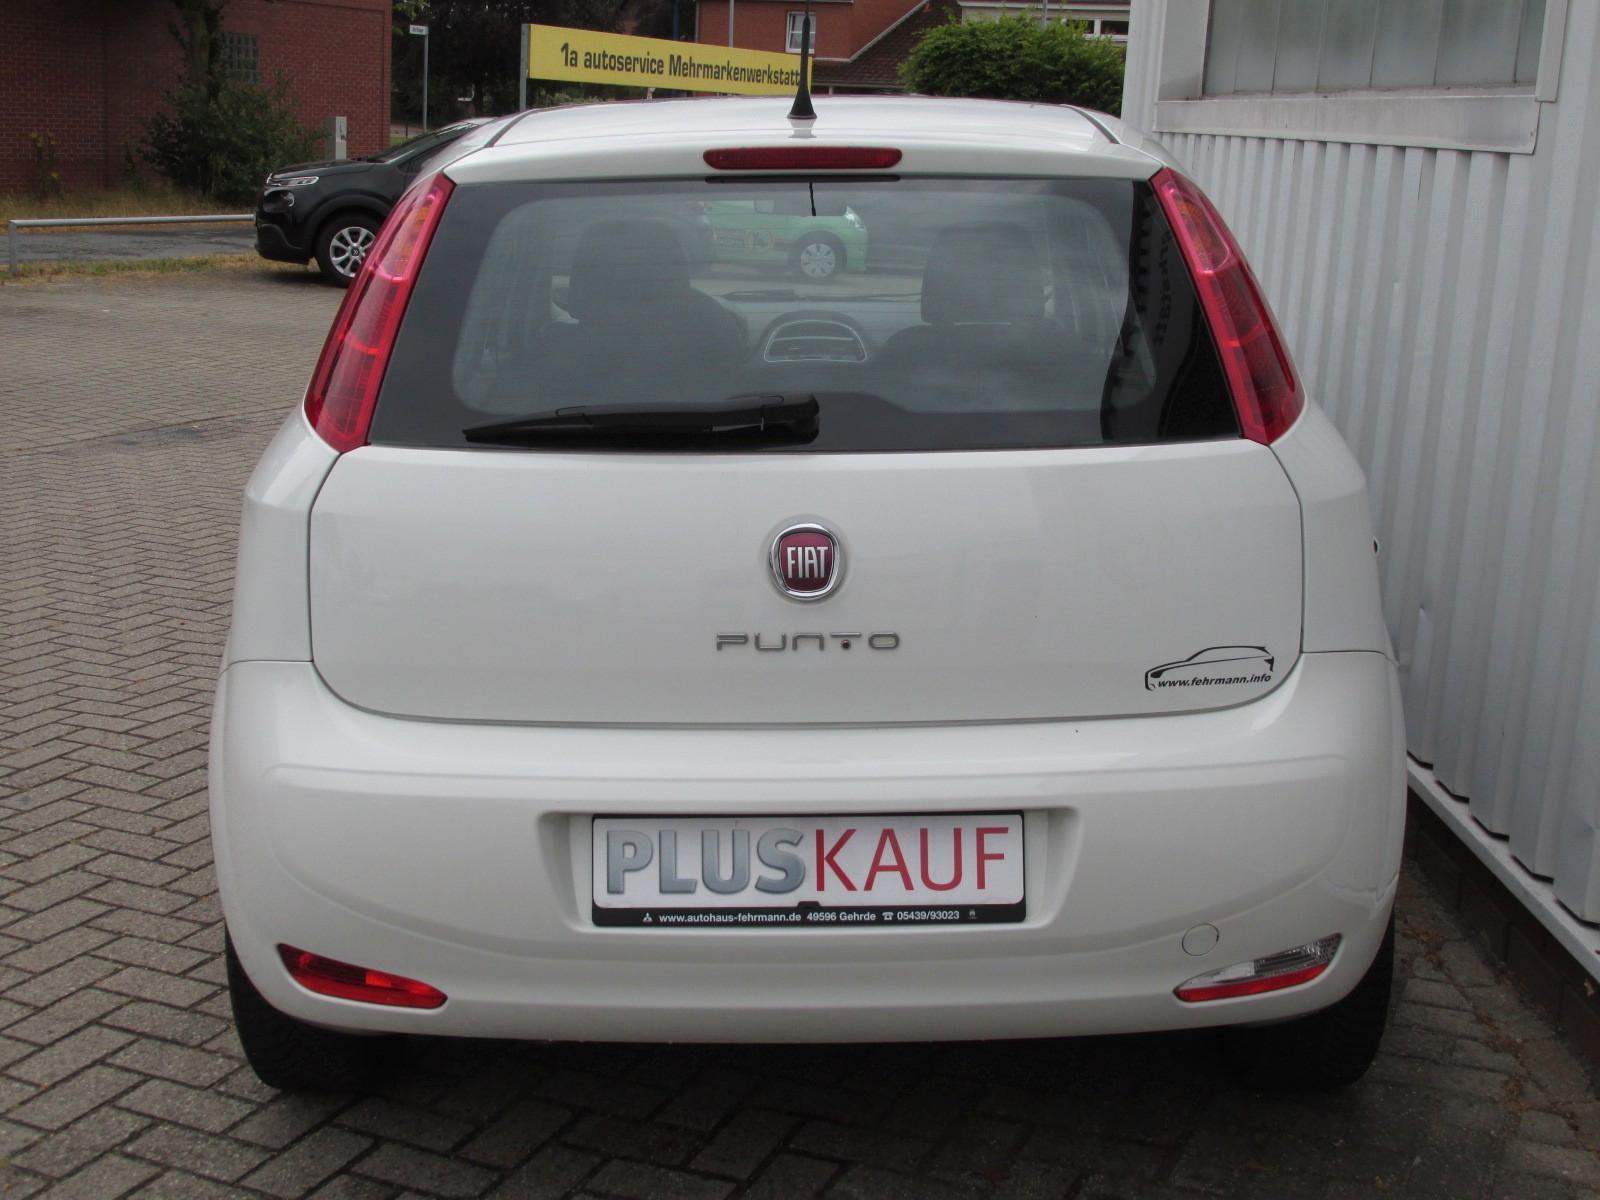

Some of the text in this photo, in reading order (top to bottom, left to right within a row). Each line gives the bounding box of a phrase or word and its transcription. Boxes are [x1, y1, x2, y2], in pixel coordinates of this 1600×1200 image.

[561, 43, 801, 86] 1a autoservice Mehrmarkenwerkstatt
[786, 546, 828, 579] FIAT
[716, 631, 900, 651] PUNTO
[1158, 673, 1272, 688] www.fehrmann.info
[659, 910, 960, 923] www.autohaus-fehrmann.de 49596 Gehrde 05439/93023
